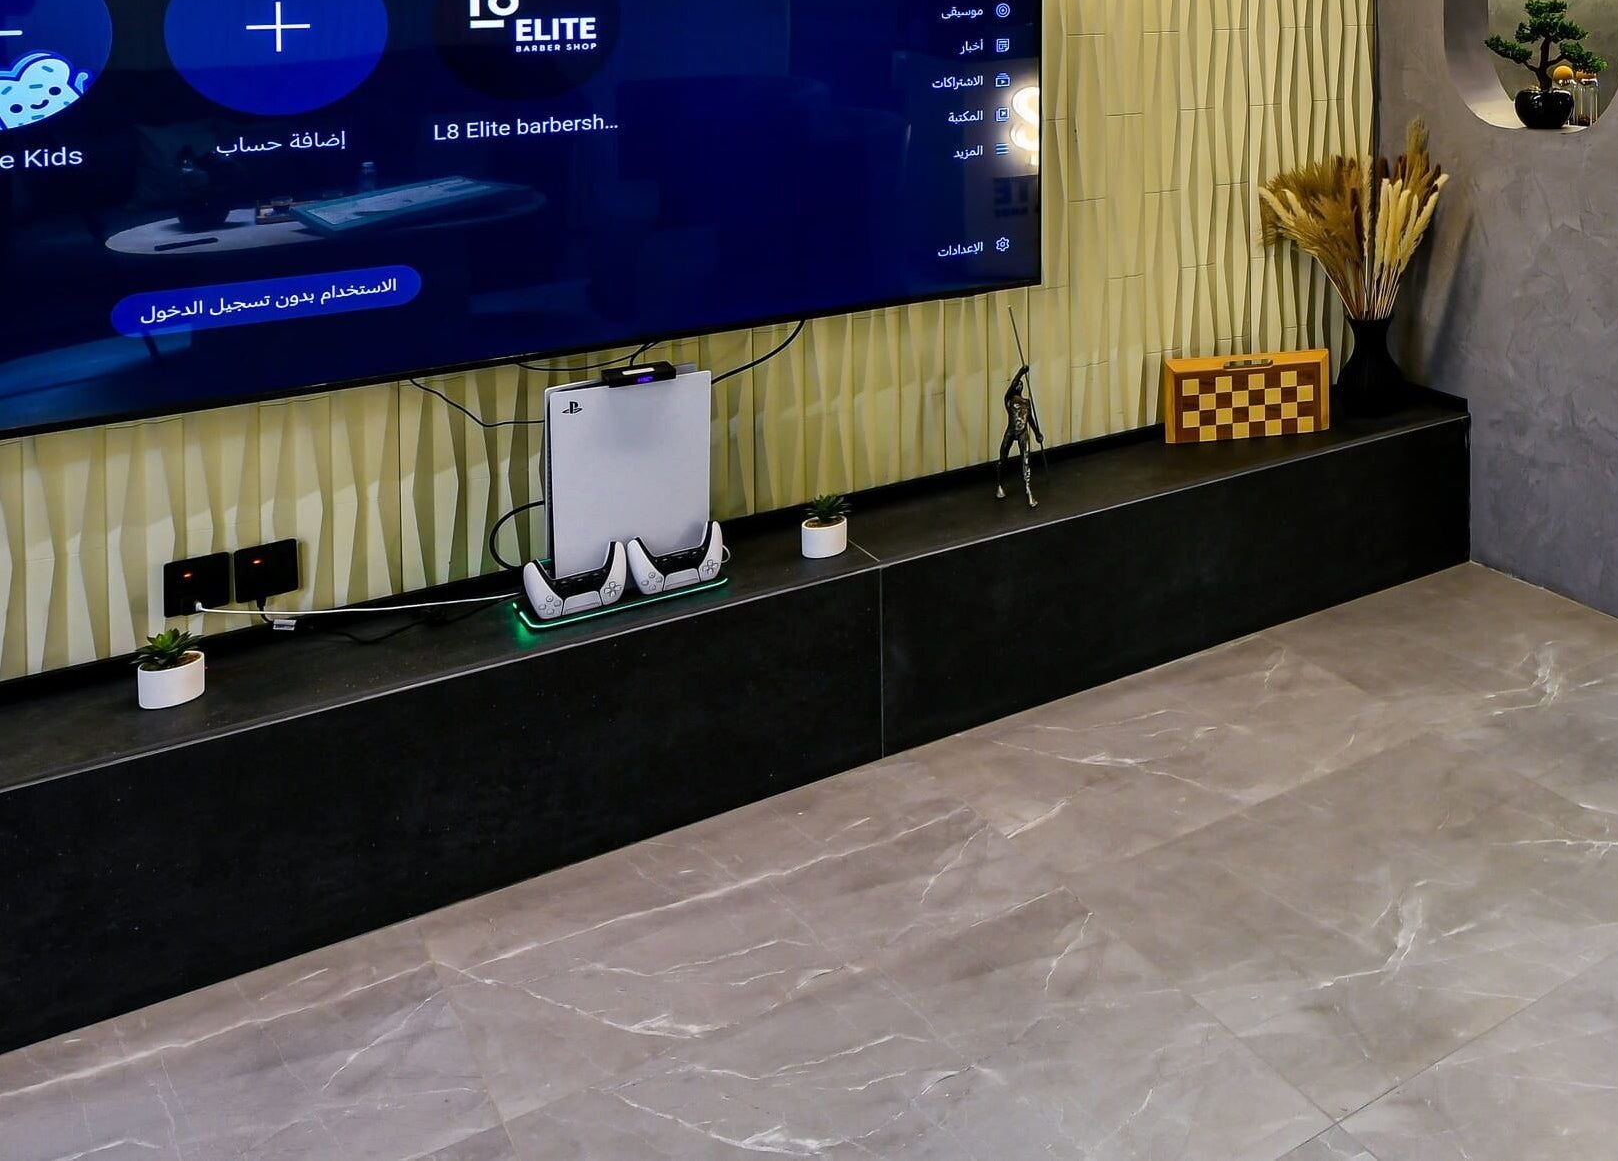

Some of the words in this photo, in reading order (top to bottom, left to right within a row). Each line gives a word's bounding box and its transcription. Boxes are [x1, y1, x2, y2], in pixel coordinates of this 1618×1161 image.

[941, 6, 984, 20] موسيقى
[515, 17, 597, 42] ELITE
[515, 44, 561, 53] BARBER
[566, 42, 597, 51] SHOP
[959, 38, 984, 55] أخبار
[931, 75, 984, 90] الاشتراكات
[947, 110, 984, 123] المكتبة
[433, 123, 459, 141] L8
[466, 120, 511, 139] Elite
[517, 114, 619, 136] barbersh...
[215, 137, 282, 155] حساب
[289, 130, 346, 150] إضافة
[24, 146, 83, 168] Kids
[953, 145, 984, 160] المزيد
[937, 241, 984, 257] الإعدادات
[319, 277, 398, 305] الاستخدام
[209, 294, 271, 317] تسجيل
[275, 293, 315, 310] بدون
[140, 300, 203, 324] الدخول
